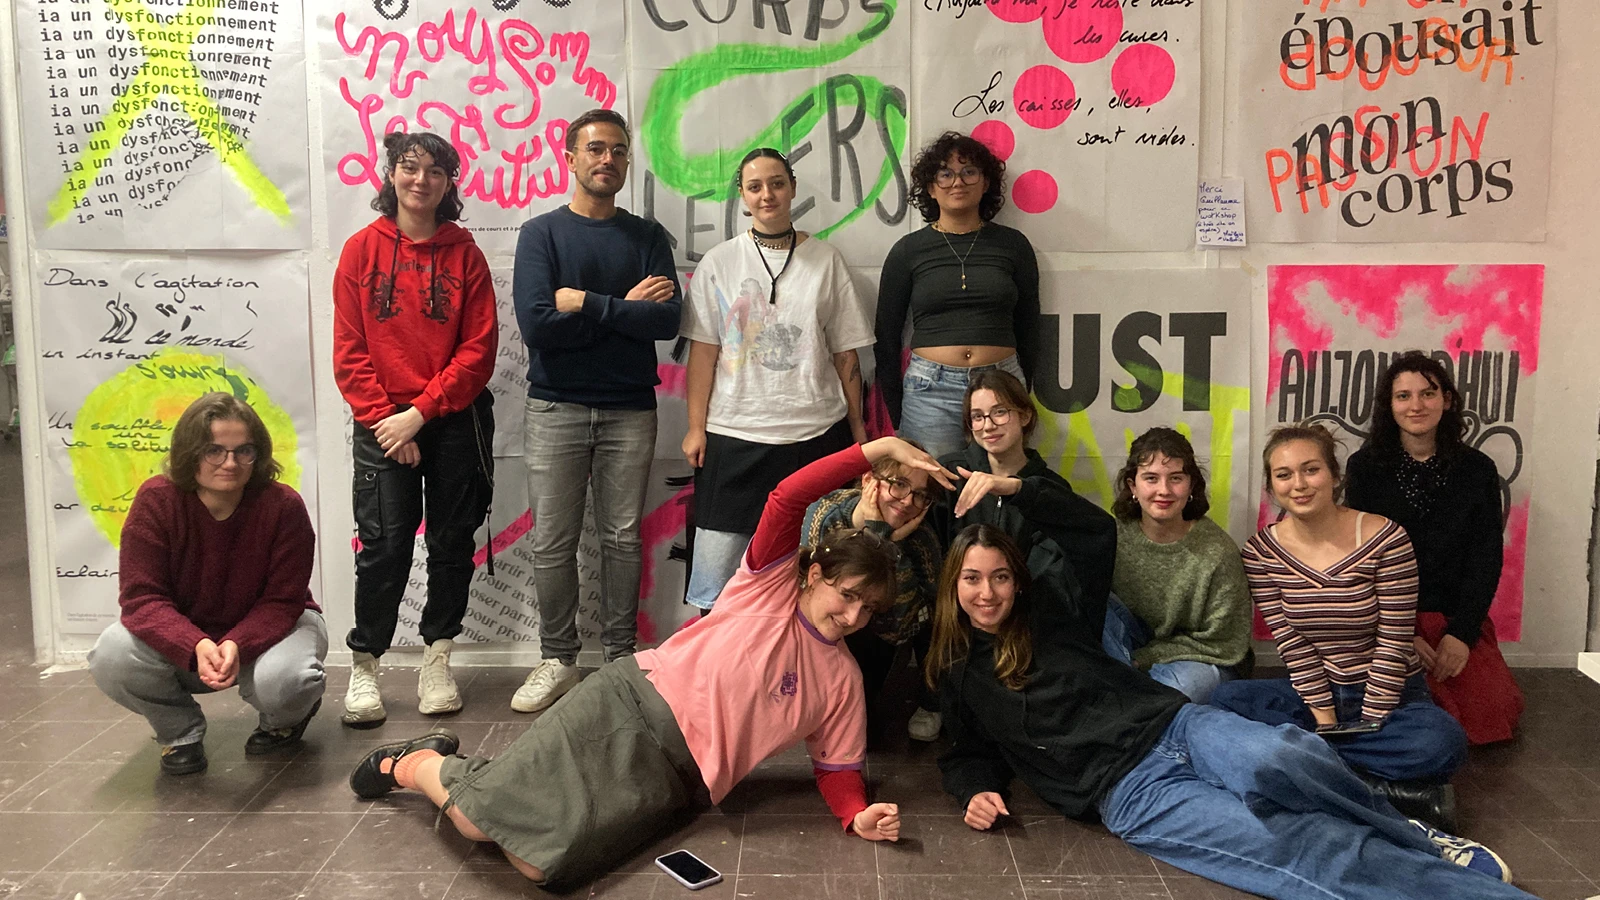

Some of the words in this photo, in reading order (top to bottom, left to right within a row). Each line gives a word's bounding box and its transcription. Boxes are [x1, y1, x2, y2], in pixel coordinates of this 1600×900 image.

[38, 9, 60, 22] ia
[71, 11, 91, 22] un
[40, 28, 62, 42] ia
[73, 29, 93, 41] un
[1280, 0, 1543, 76] épousait
[43, 47, 65, 60] ia
[76, 47, 96, 60] un
[46, 66, 67, 79] ia
[78, 66, 97, 79] un
[49, 85, 69, 98] ia
[80, 85, 98, 97] un
[952, 70, 1005, 118] Les
[51, 104, 72, 117] ia
[81, 103, 100, 115] un
[53, 122, 75, 136] ia
[83, 120, 106, 133] un
[1077, 126, 1126, 146] sont
[57, 141, 79, 155] ia
[89, 138, 110, 151] un
[1292, 96, 1447, 194] mon
[61, 160, 84, 173] ia
[93, 157, 112, 169] un
[67, 178, 86, 191] ia
[95, 173, 114, 187] un
[73, 196, 91, 209] ia
[98, 191, 119, 204] un
[1341, 158, 1514, 228] corps
[44, 268, 109, 287] Dans
